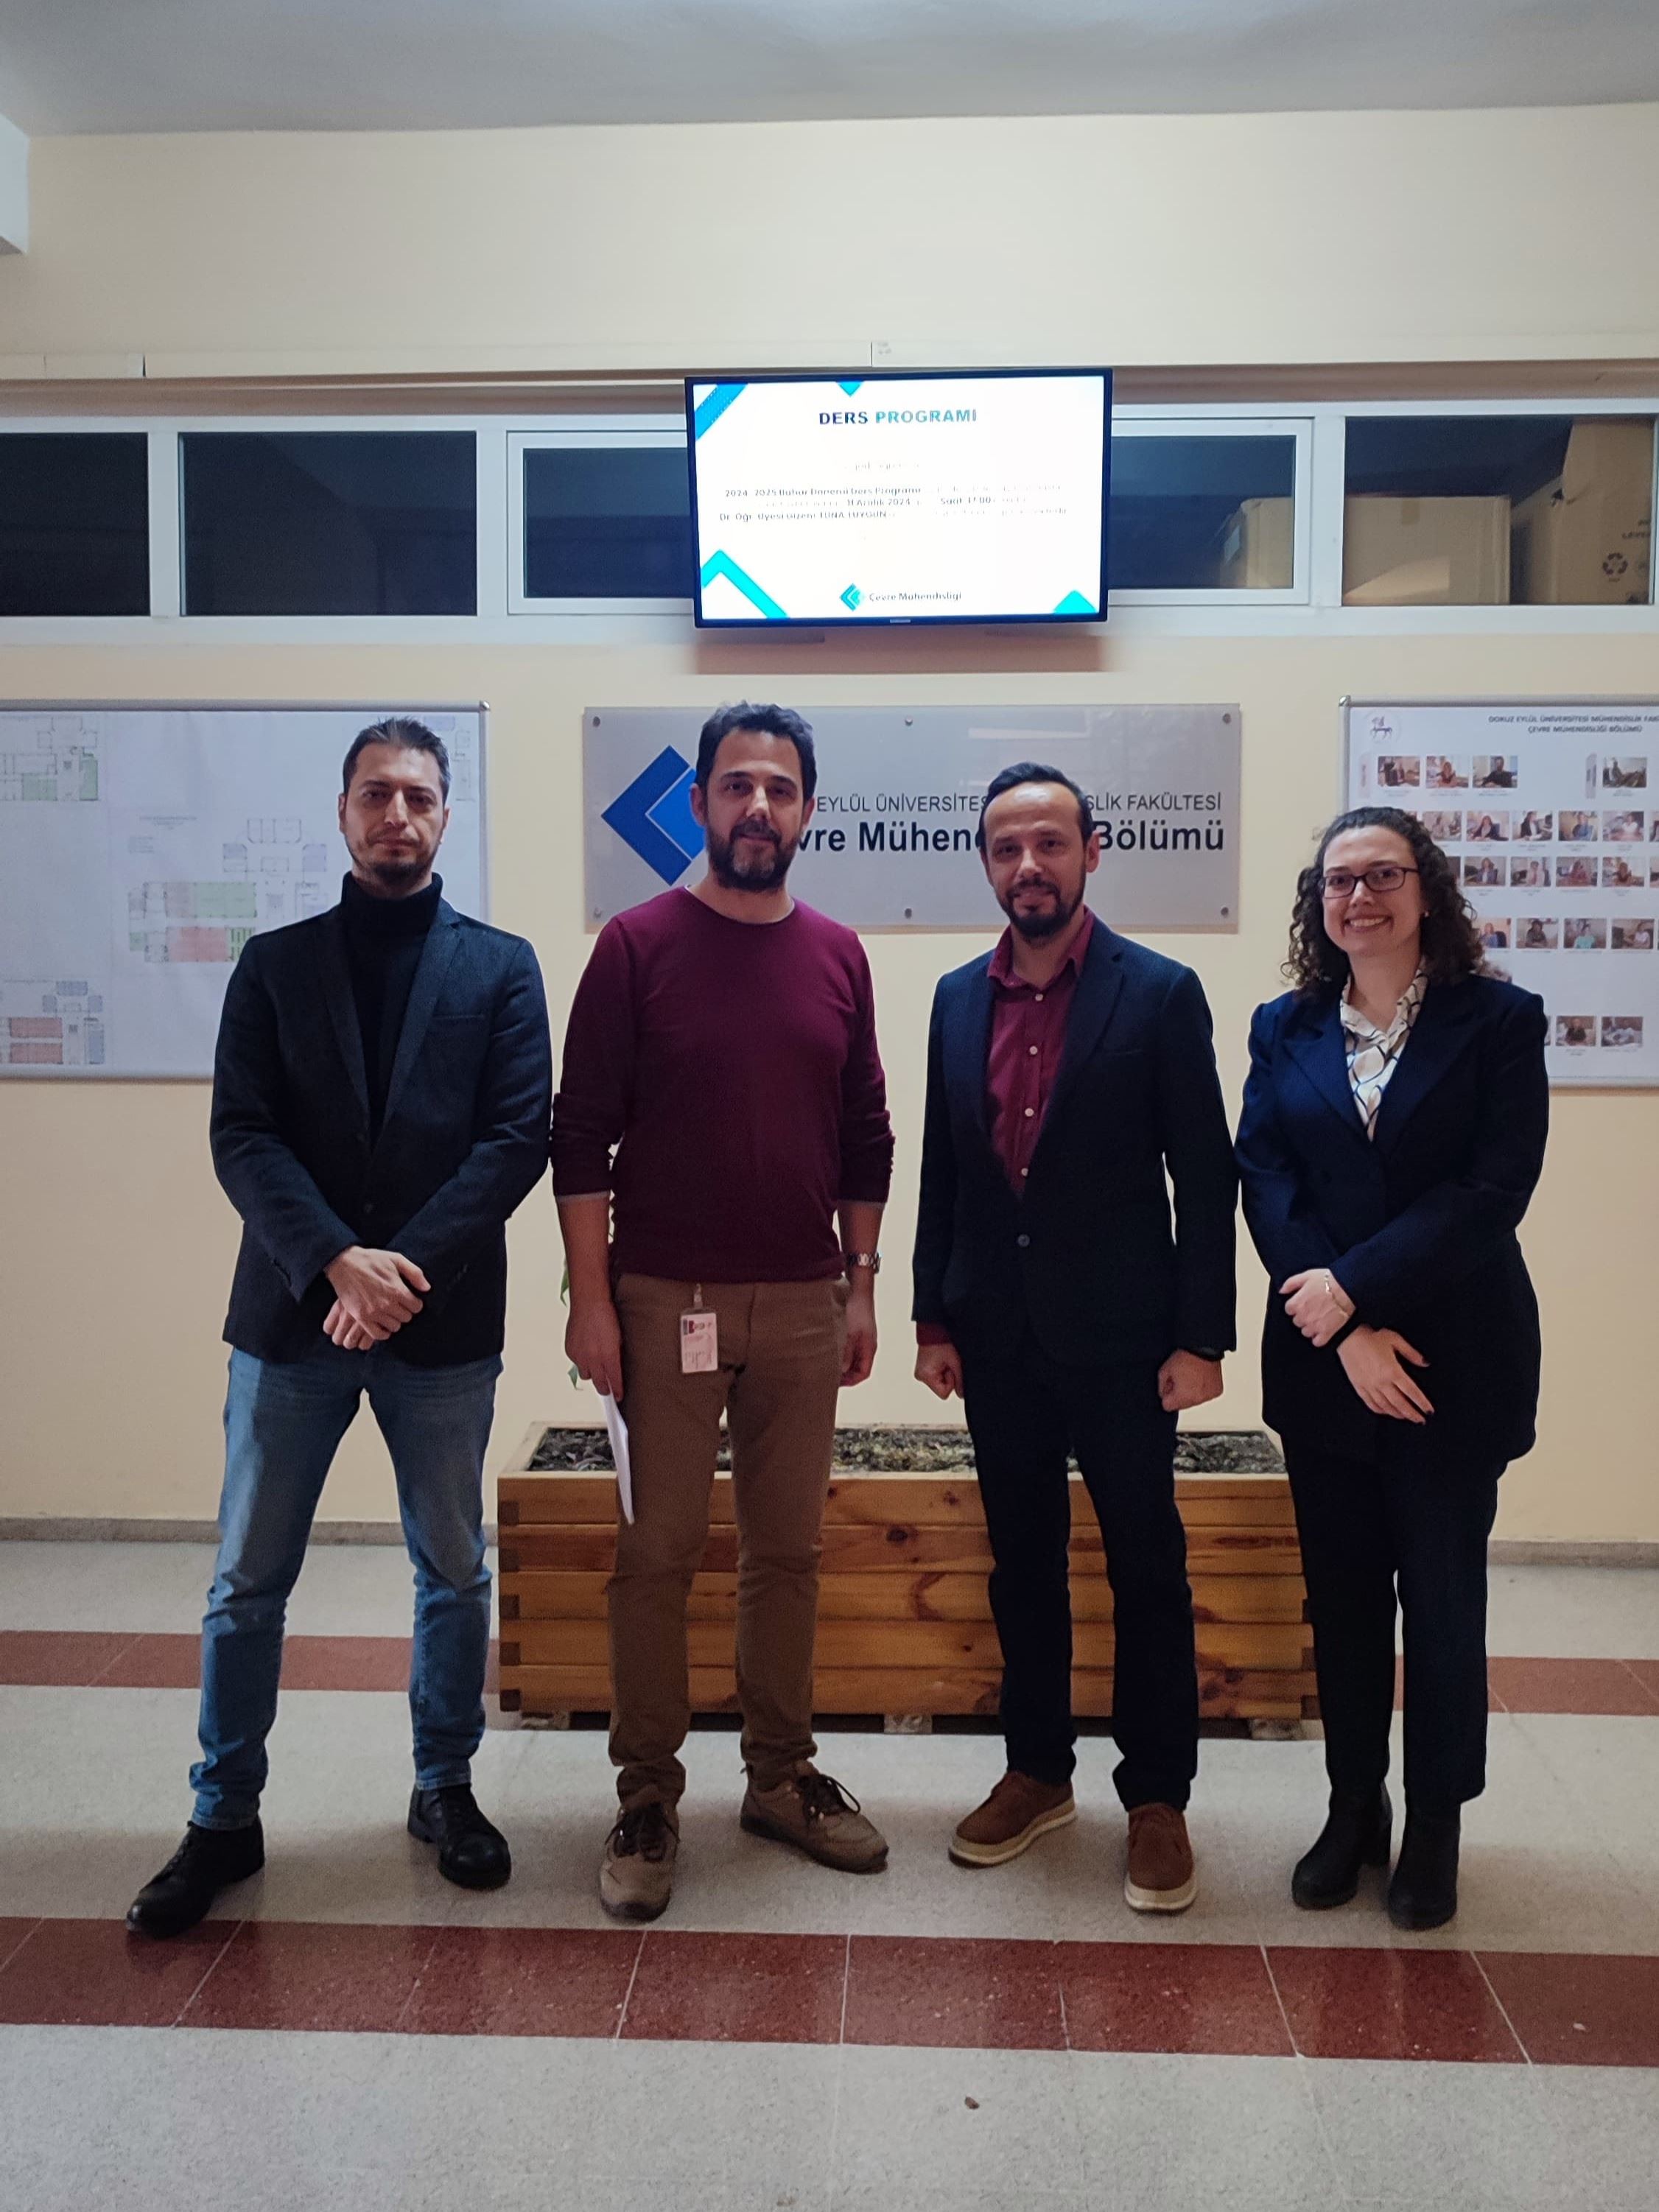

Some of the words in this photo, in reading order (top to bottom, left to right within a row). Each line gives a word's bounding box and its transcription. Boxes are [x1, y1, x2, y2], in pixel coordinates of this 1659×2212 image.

[819, 412, 868, 424] DERS
[875, 409, 976, 424] PROGRAMI
[816, 793, 870, 812] EYLÜL
[875, 793, 988, 812] ÜNİVERSİTES
[1127, 791, 1221, 811] FAKÜLTESİ
[799, 829, 846, 852] vre
[859, 821, 981, 852] Mühen
[1093, 819, 1224, 850] Bölümü
